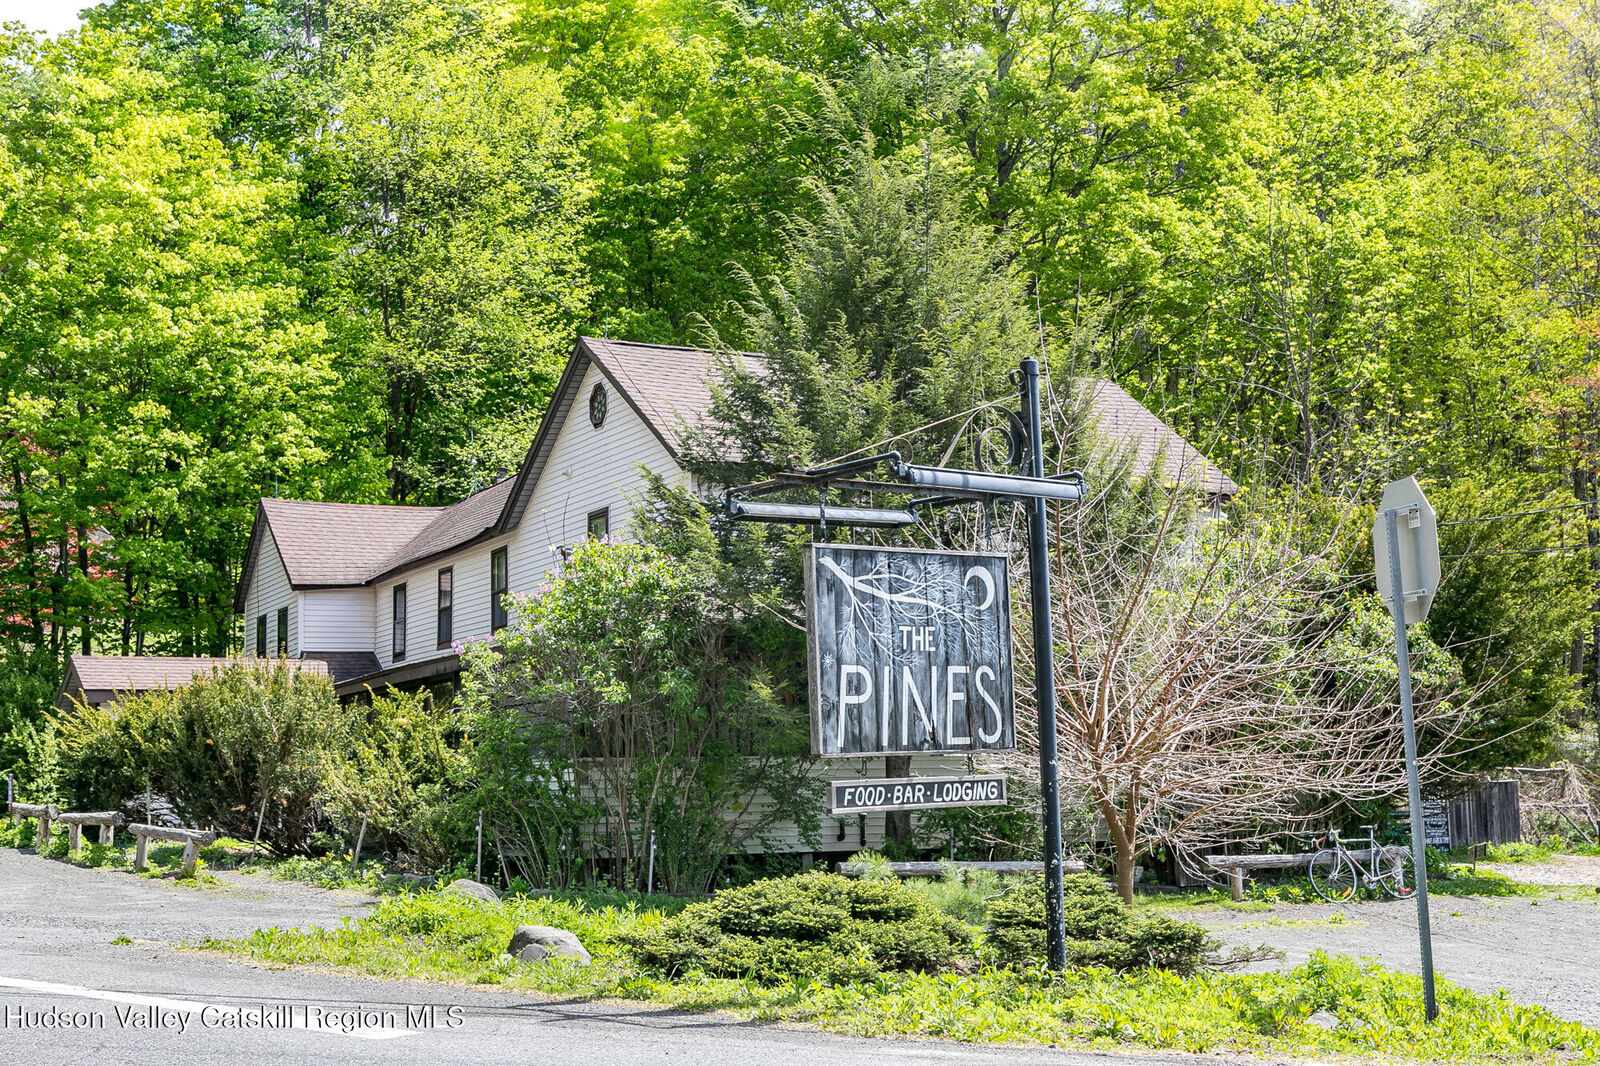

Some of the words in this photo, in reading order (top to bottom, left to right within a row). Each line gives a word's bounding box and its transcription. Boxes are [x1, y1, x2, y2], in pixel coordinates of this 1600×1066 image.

[899, 625, 936, 652] THE
[837, 664, 1003, 748] PINES
[843, 786, 885, 806] FOOD
[890, 784, 925, 803] BAR
[933, 781, 998, 801] LODGING
